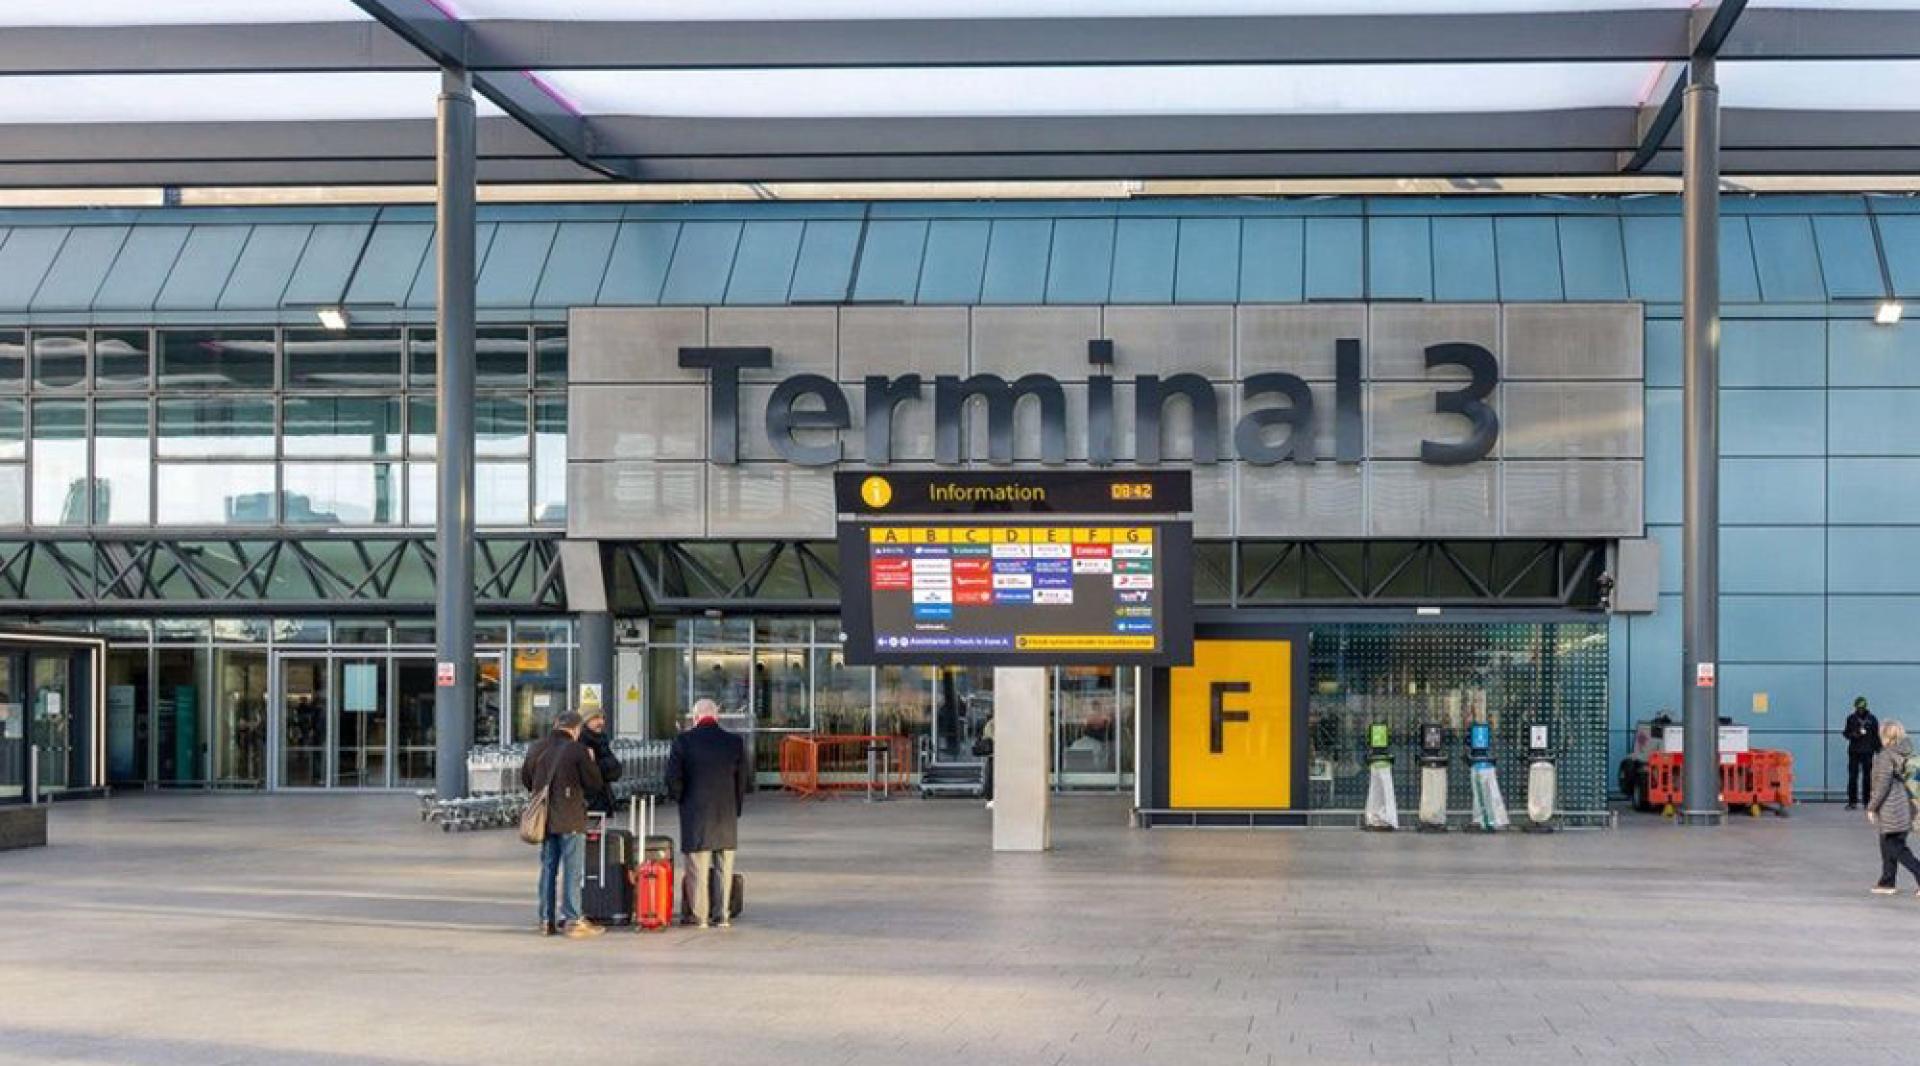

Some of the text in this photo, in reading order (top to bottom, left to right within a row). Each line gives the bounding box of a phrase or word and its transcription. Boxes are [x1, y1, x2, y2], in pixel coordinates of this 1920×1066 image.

[678, 339, 1500, 467] Terminal 3
[929, 483, 1046, 501] Information
[884, 529, 1139, 543] A B C D E F G
[1211, 682, 1251, 753] F
